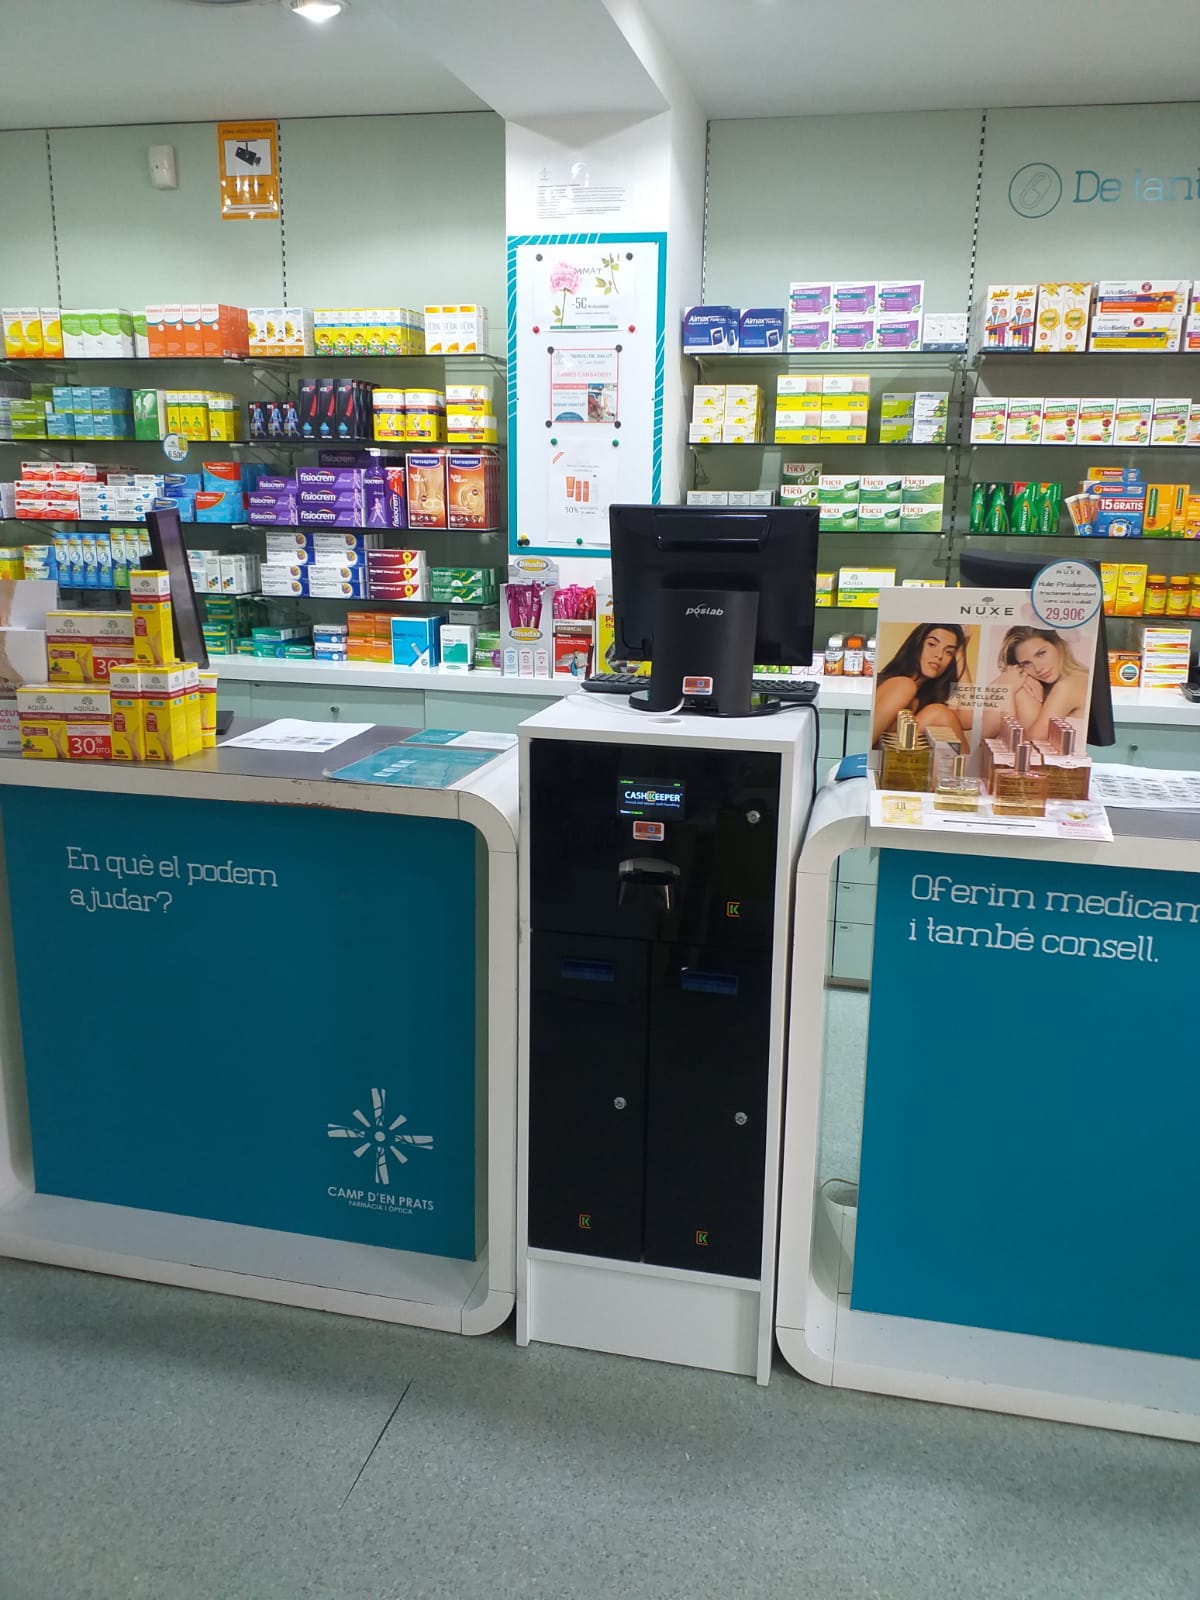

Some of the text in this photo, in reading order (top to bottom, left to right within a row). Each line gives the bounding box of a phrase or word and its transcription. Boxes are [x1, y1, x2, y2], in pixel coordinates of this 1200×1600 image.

[1073, 170, 1121, 203] De
[300, 473, 336, 482] fisiocrem
[300, 491, 336, 501] fisiocrem
[1100, 498, 1144, 510] 15 GRATIS
[250, 512, 276, 520] fisiocrem
[300, 510, 336, 520] fisiocrem
[685, 604, 724, 618] poslab
[960, 606, 1015, 616] NUXE
[1045, 607, 1085, 621] 29,90€
[66, 846, 278, 887] En què el podem
[911, 874, 1036, 910] Oferim
[70, 887, 173, 913] ajudar?
[908, 917, 1159, 963] i també consell.
[327, 1186, 434, 1211] CAMP D'EN PRATS
